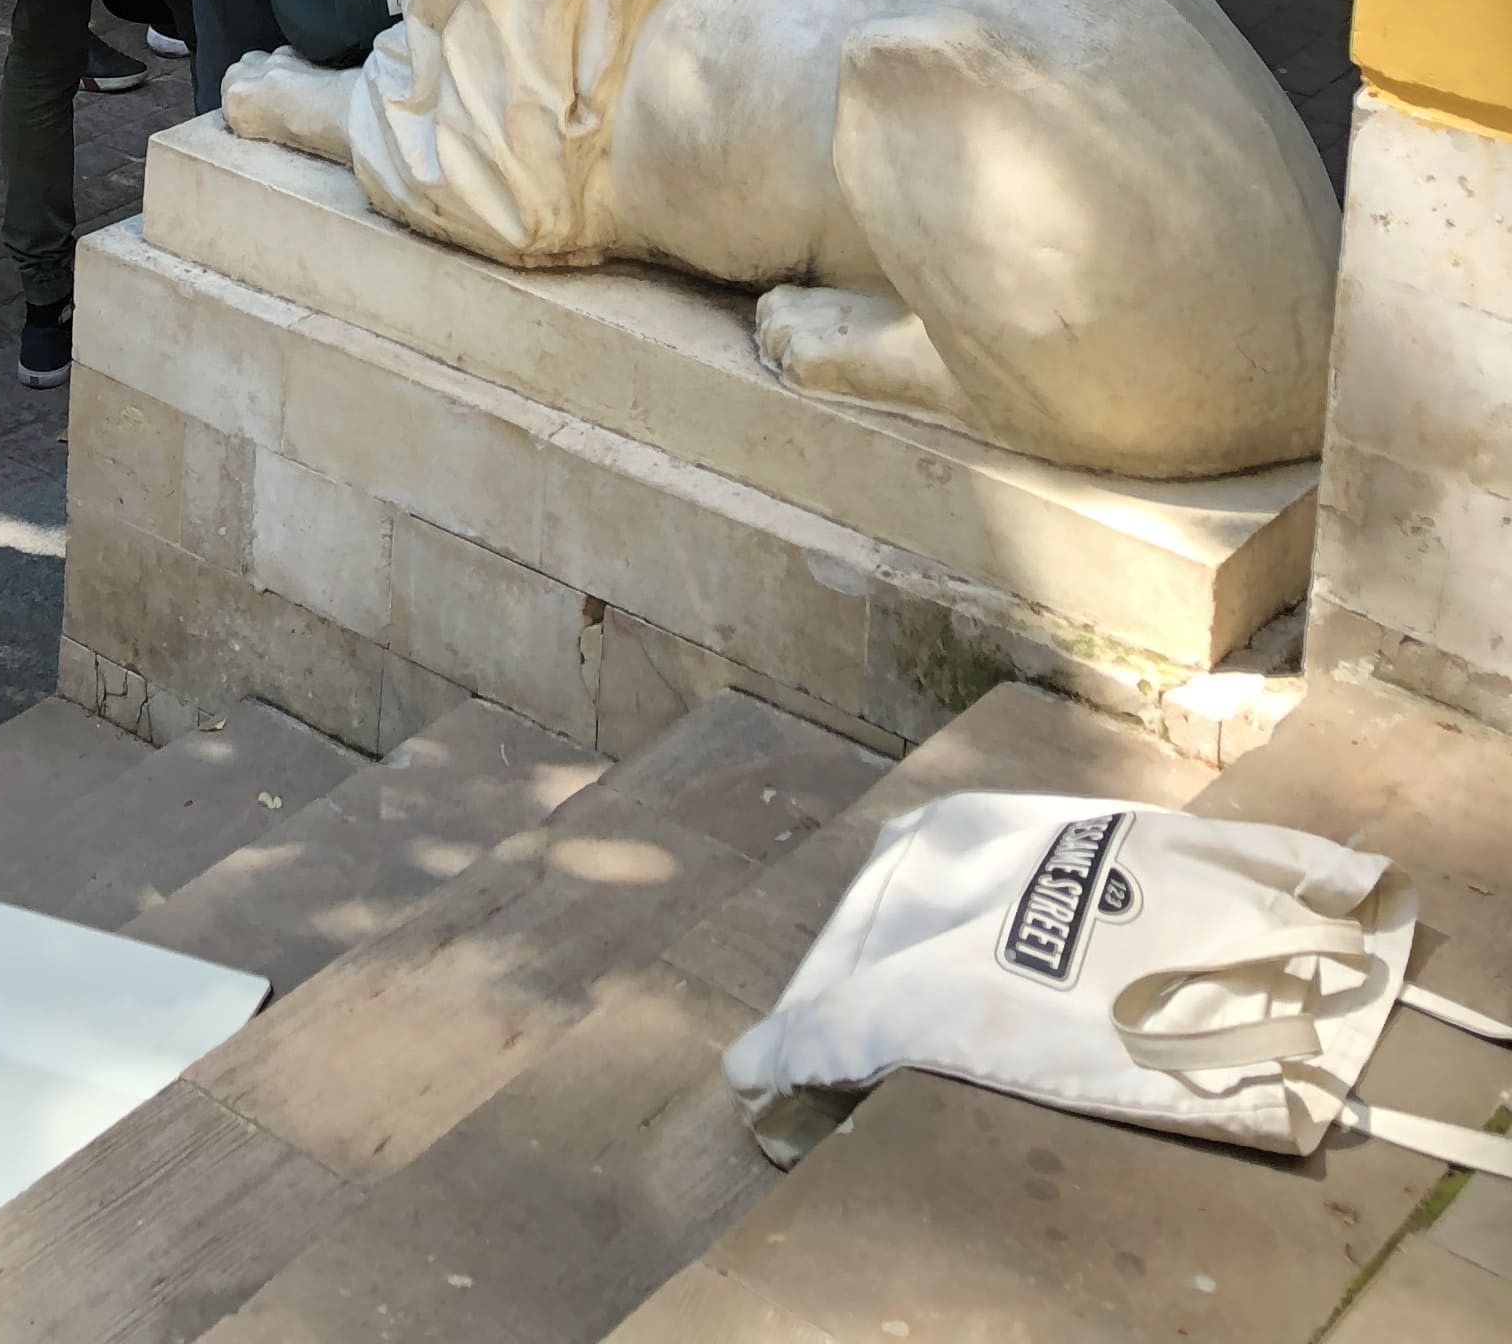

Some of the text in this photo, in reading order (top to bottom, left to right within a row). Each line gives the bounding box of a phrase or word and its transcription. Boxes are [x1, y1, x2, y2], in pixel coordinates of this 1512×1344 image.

[1015, 814, 1113, 970] ESAME STREET
[1105, 878, 1127, 909] 123
